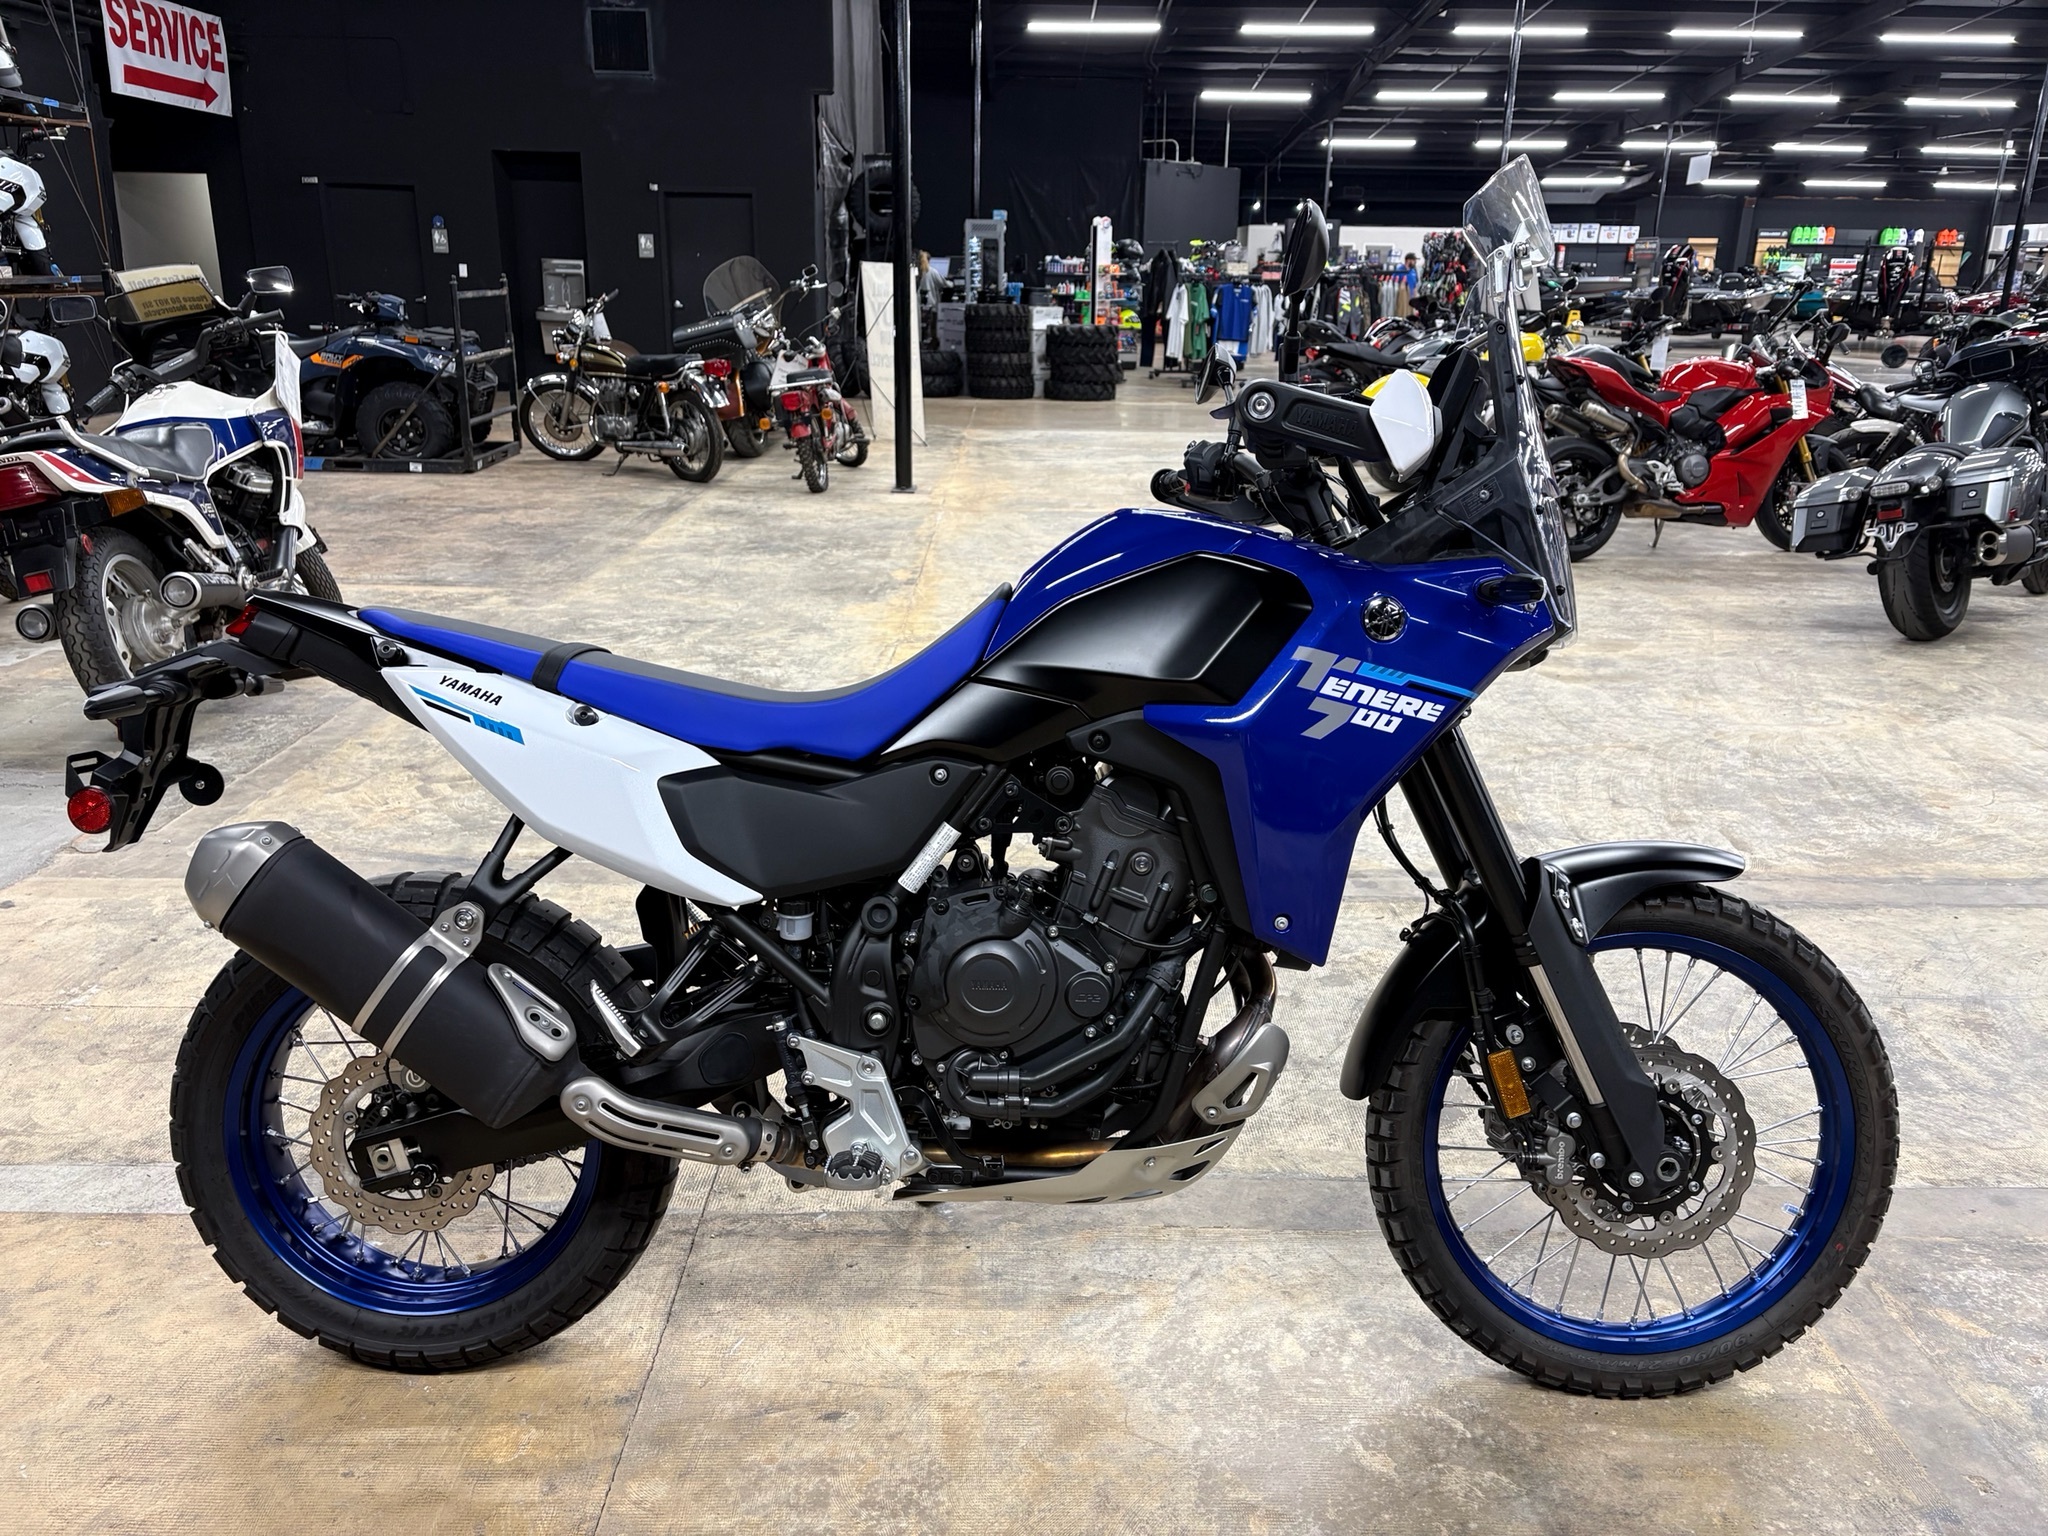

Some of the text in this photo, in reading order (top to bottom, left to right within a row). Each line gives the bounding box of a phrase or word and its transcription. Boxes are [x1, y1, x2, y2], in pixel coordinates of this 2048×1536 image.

[104, 0, 225, 74] SERVICE
[1295, 406, 1360, 438] YAMAHA
[0, 456, 23, 465] NDA
[439, 675, 503, 706] YAMAHA
[1553, 1141, 1566, 1180] brembo
[395, 1321, 460, 1340] STR
